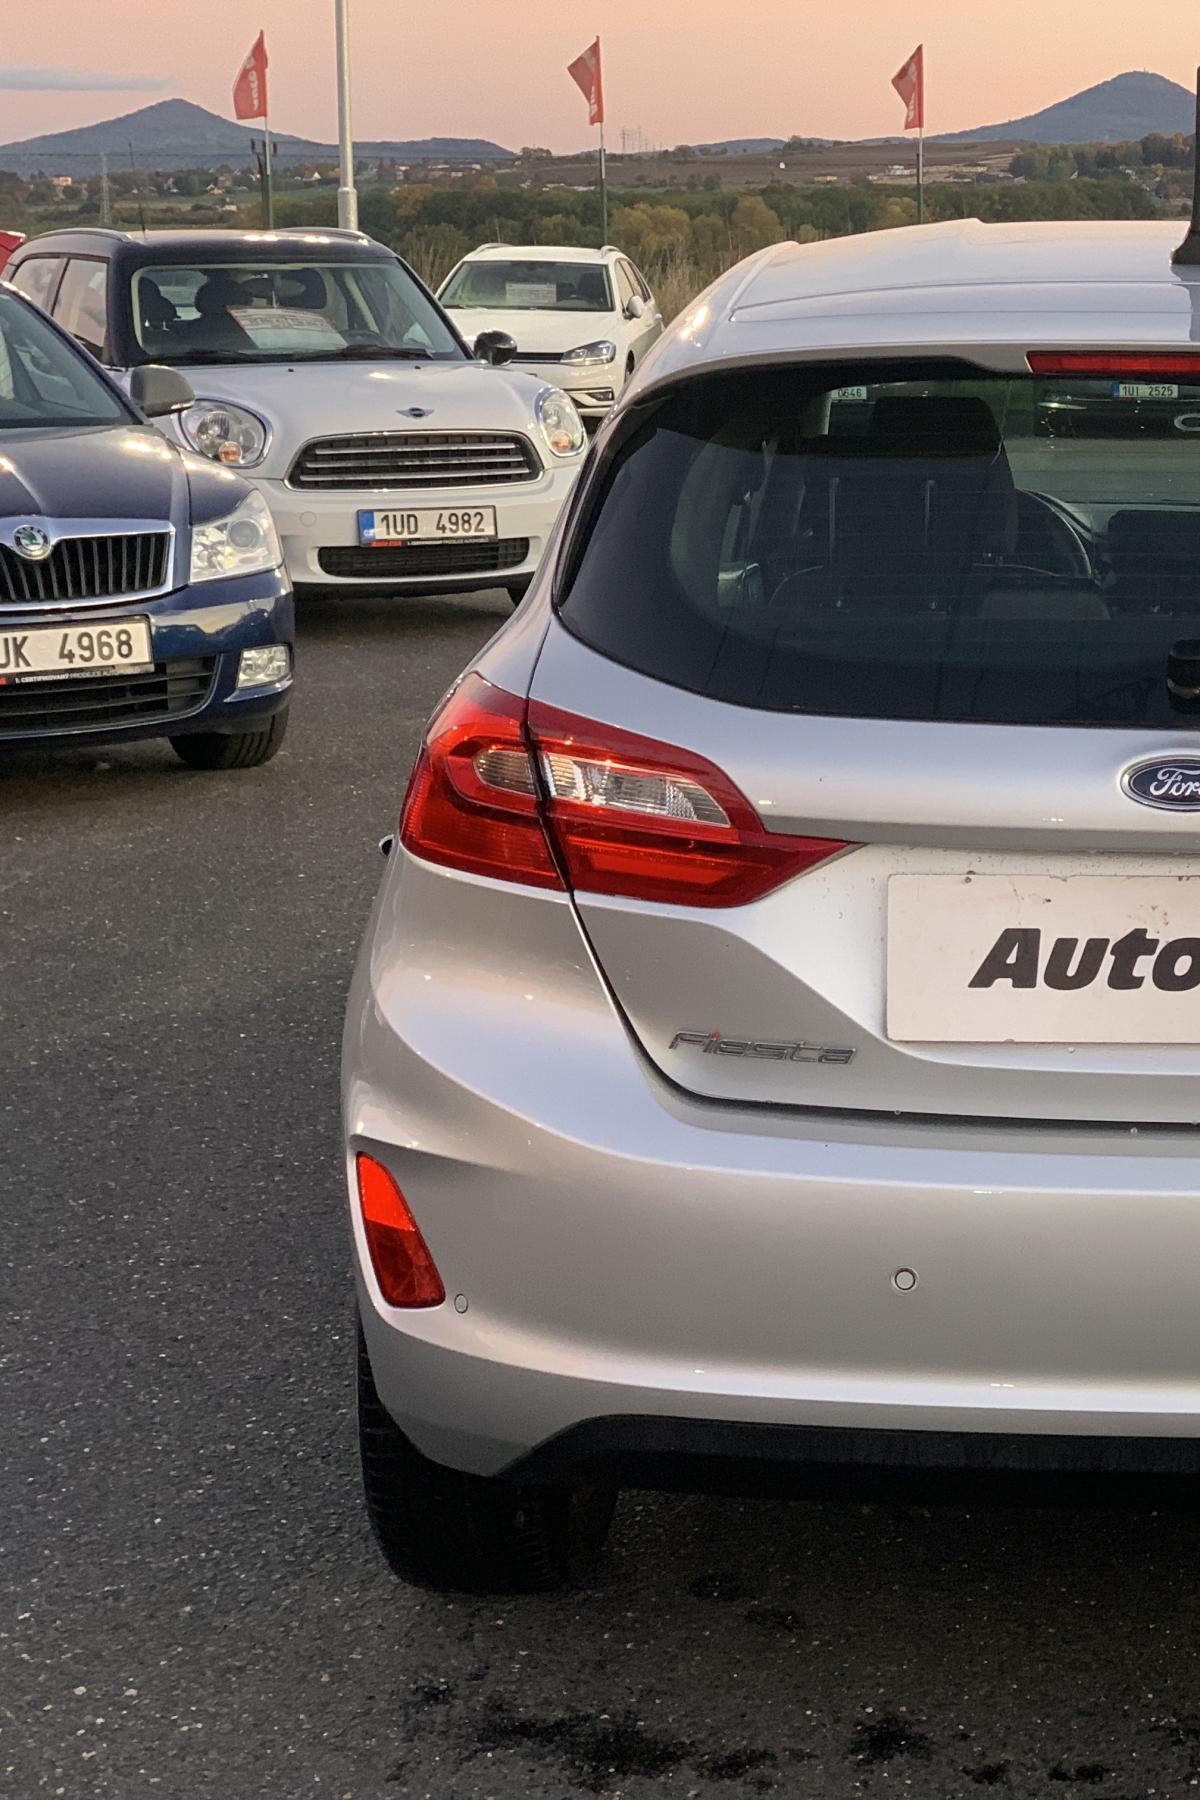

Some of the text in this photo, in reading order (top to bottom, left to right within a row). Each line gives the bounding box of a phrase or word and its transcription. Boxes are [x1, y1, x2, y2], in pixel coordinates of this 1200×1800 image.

[1148, 385, 1174, 397] 2525
[381, 513, 418, 536] 1UD
[436, 511, 486, 535] 4982
[58, 629, 134, 664] 4968
[668, 1030, 858, 1065] Fiesta
